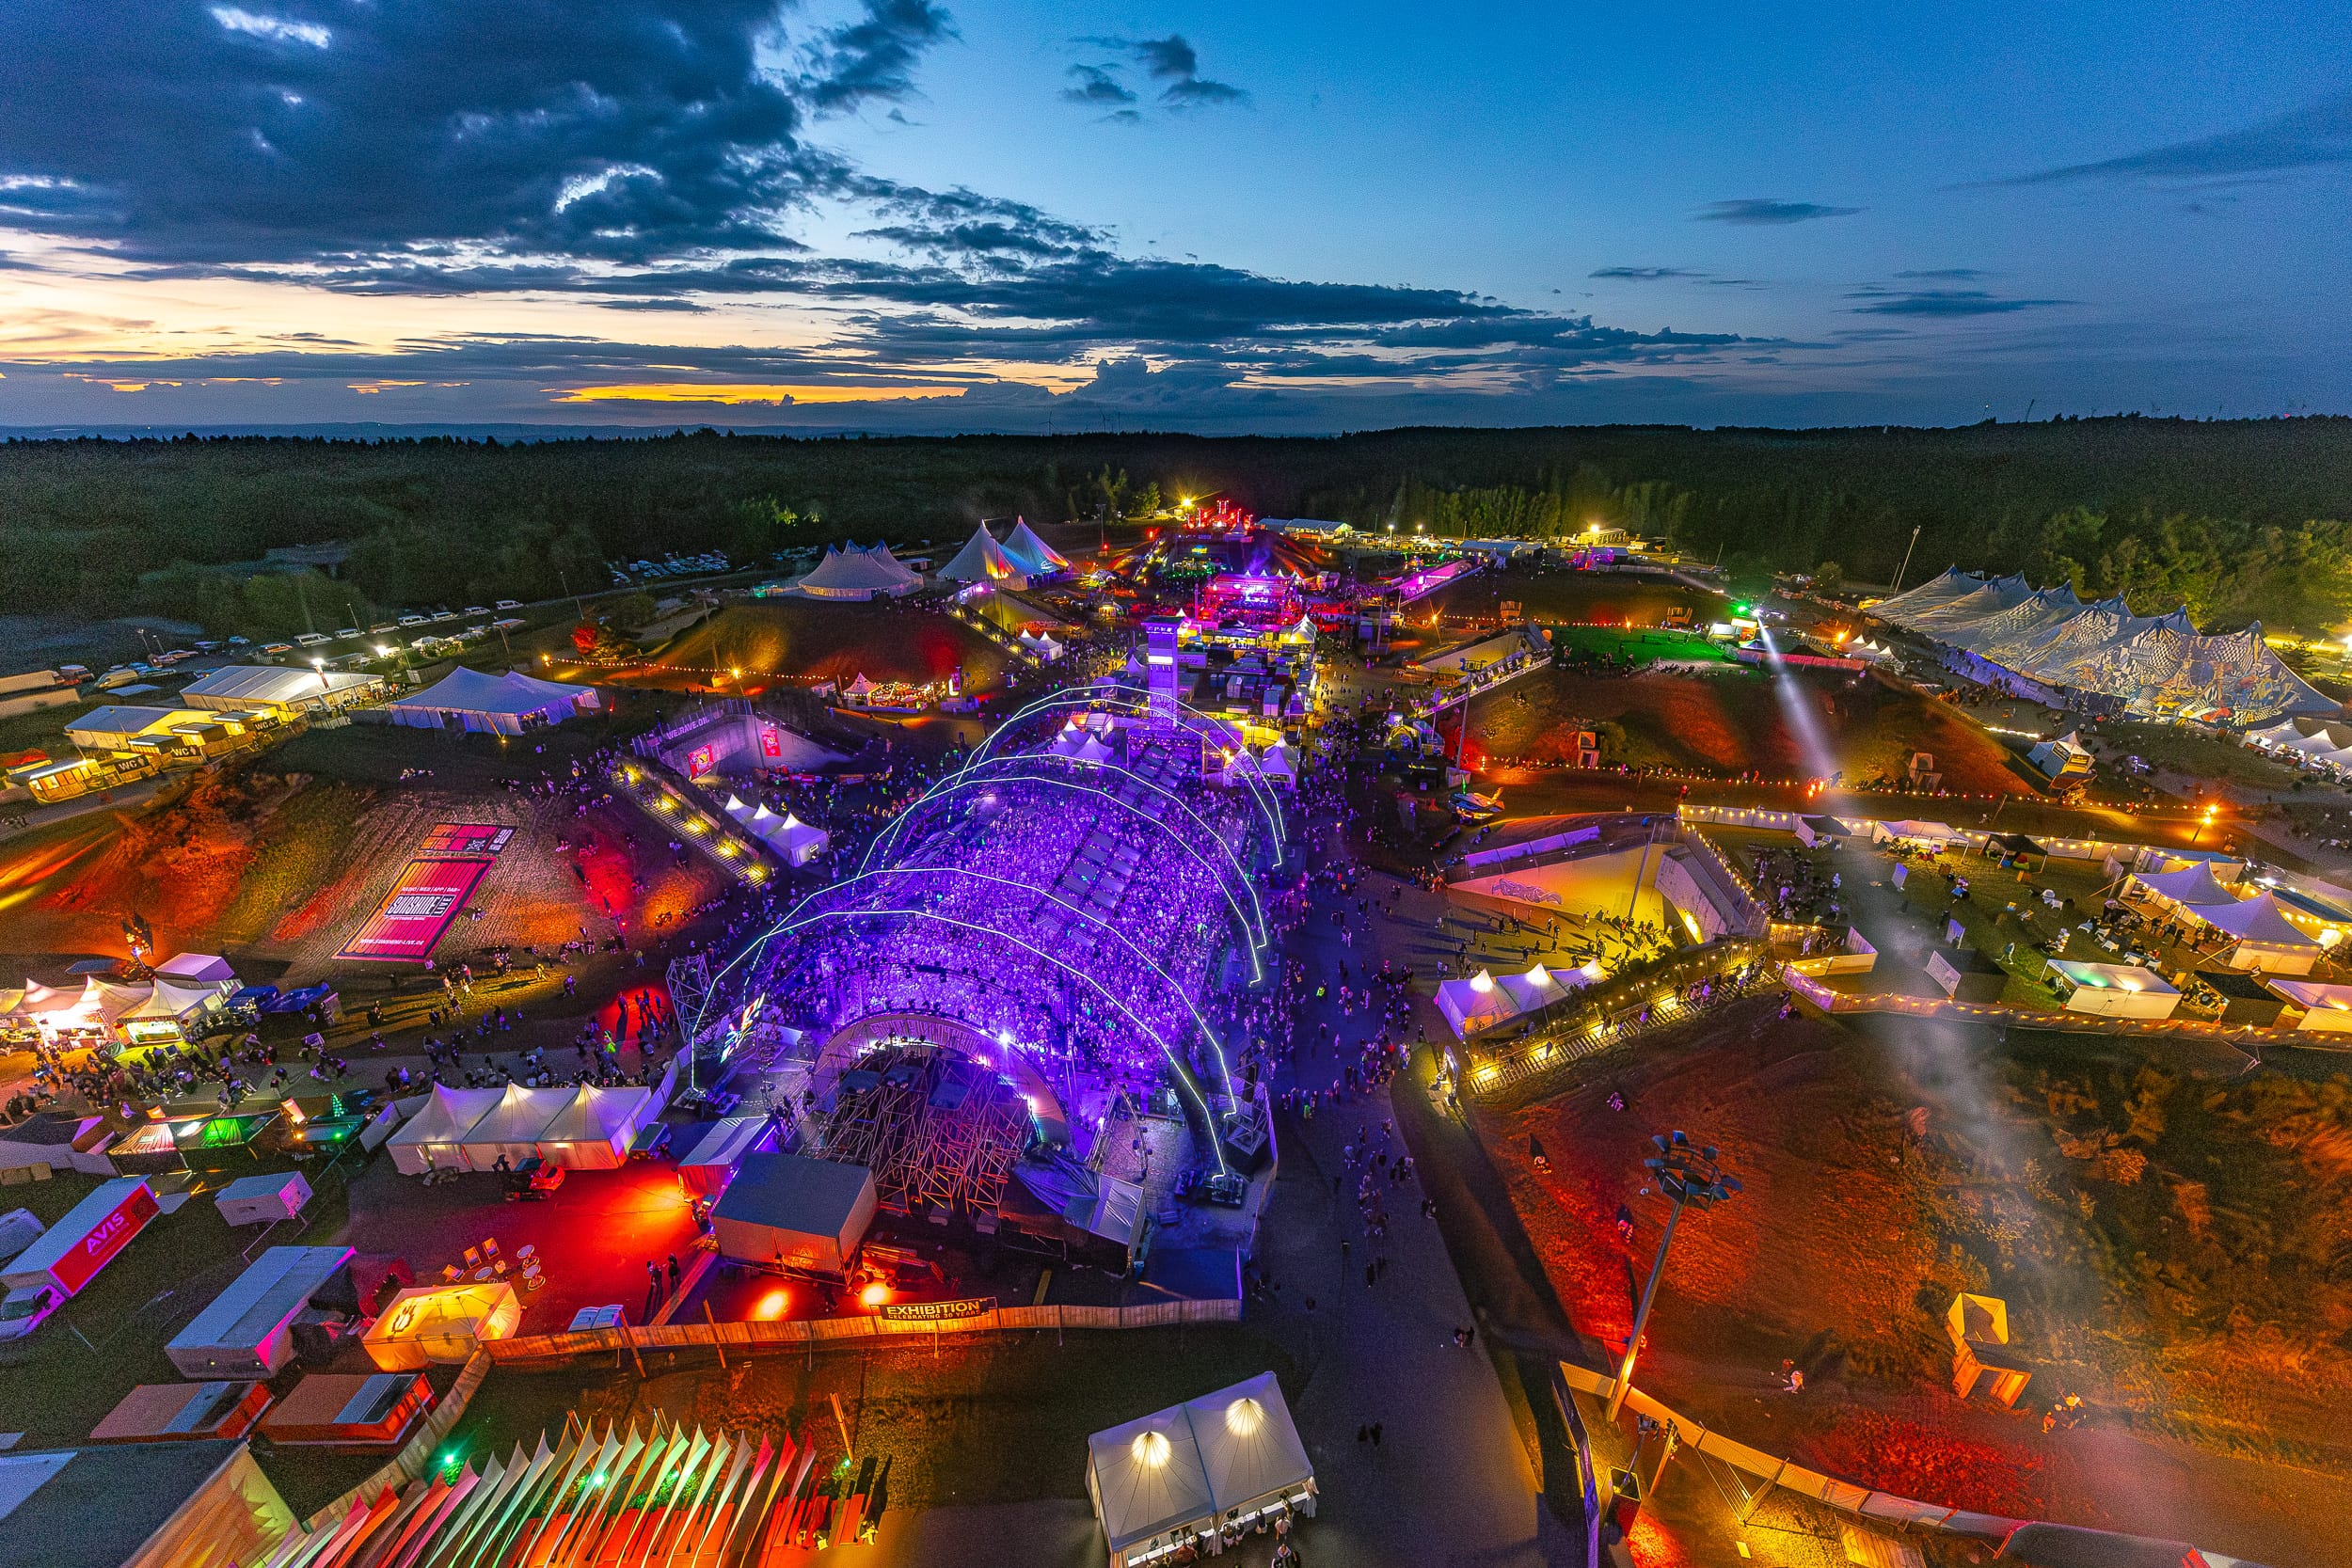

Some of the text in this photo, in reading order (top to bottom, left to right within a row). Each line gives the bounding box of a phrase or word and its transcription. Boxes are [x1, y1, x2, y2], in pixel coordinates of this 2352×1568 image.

[255, 721, 268, 731] WC
[172, 746, 189, 756] WC
[119, 759, 137, 771] WC
[388, 895, 453, 915] SUNSHINE LIVE
[87, 1212, 124, 1253] AVIS
[886, 1302, 980, 1315] EXHIBITION
